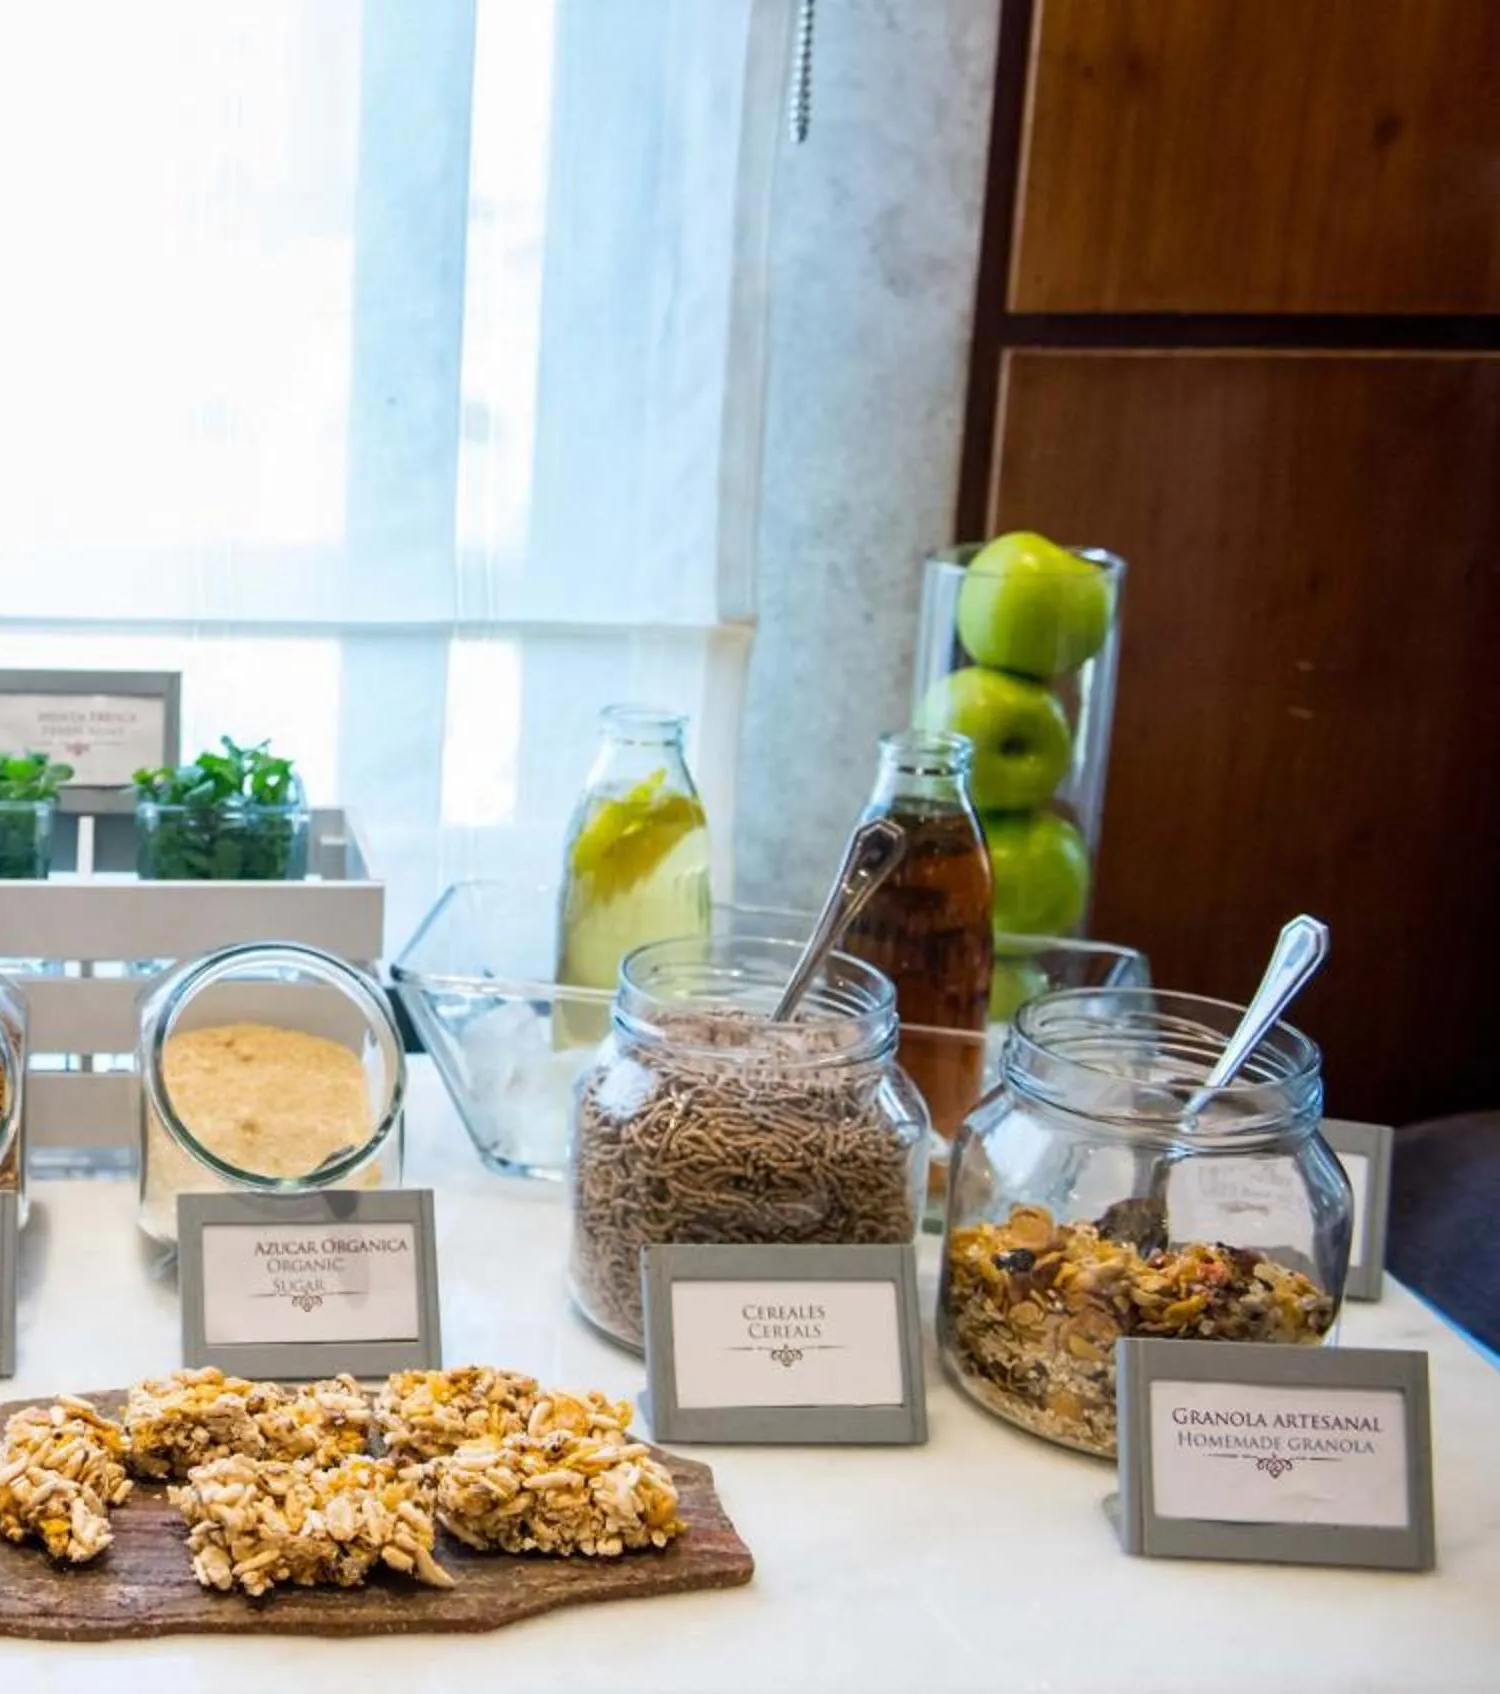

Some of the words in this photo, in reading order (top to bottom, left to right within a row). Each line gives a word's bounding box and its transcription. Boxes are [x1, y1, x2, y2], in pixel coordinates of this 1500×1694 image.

[255, 1240, 317, 1256] AZUCAR
[321, 1238, 409, 1254] ORGANICA
[266, 1257, 345, 1274] ORGANIC
[273, 1279, 325, 1292] SUGAR
[742, 1304, 825, 1320] CEREALES
[748, 1322, 821, 1339] CEREALS
[1172, 1407, 1268, 1428] GRANOLA
[1273, 1413, 1383, 1433] ARTESANAL
[1178, 1430, 1281, 1450] HOMEMADE
[1287, 1436, 1375, 1454] GRANOLA
